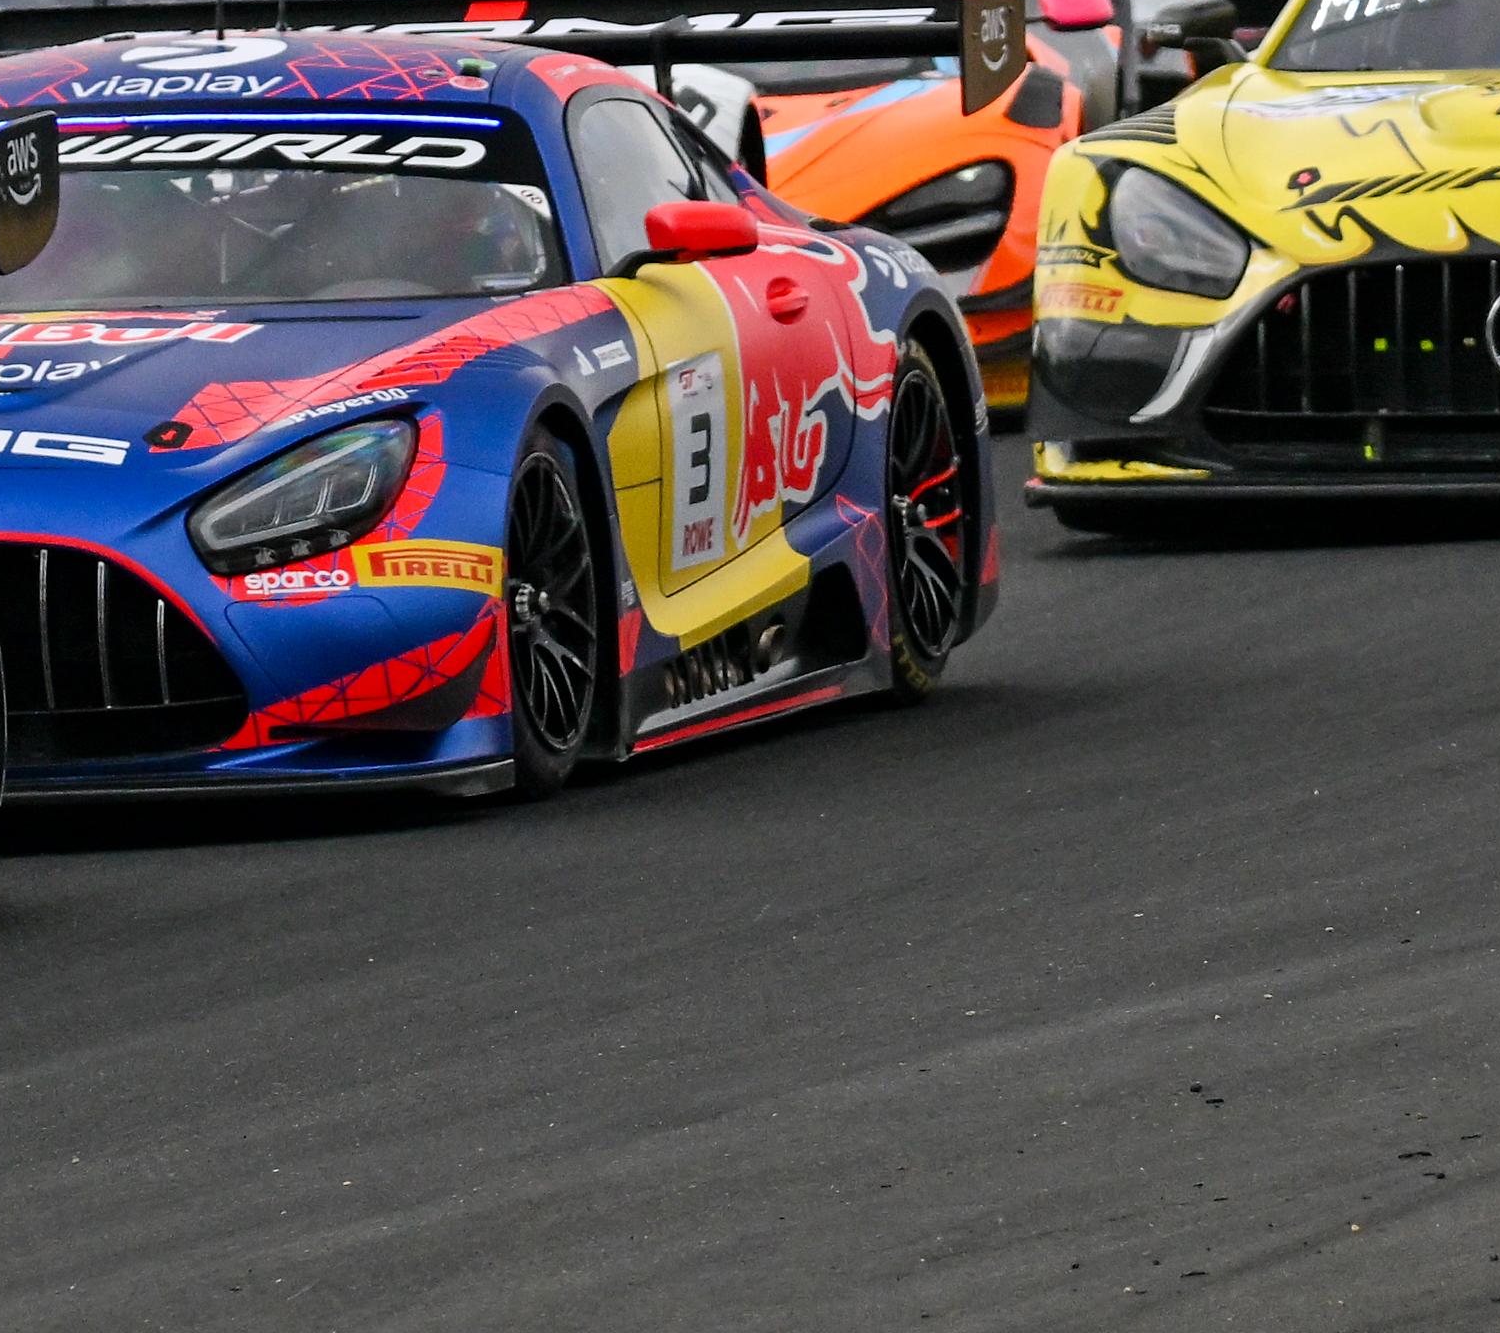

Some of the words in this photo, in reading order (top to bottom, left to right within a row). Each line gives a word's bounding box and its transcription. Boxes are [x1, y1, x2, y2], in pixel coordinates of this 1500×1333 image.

[71, 71, 284, 99] viaplay
[6, 132, 39, 176] aws
[57, 132, 488, 169] WORLD
[689, 412, 712, 505] 3
[244, 566, 351, 592] sparco
[368, 548, 494, 586] PIRELLI
